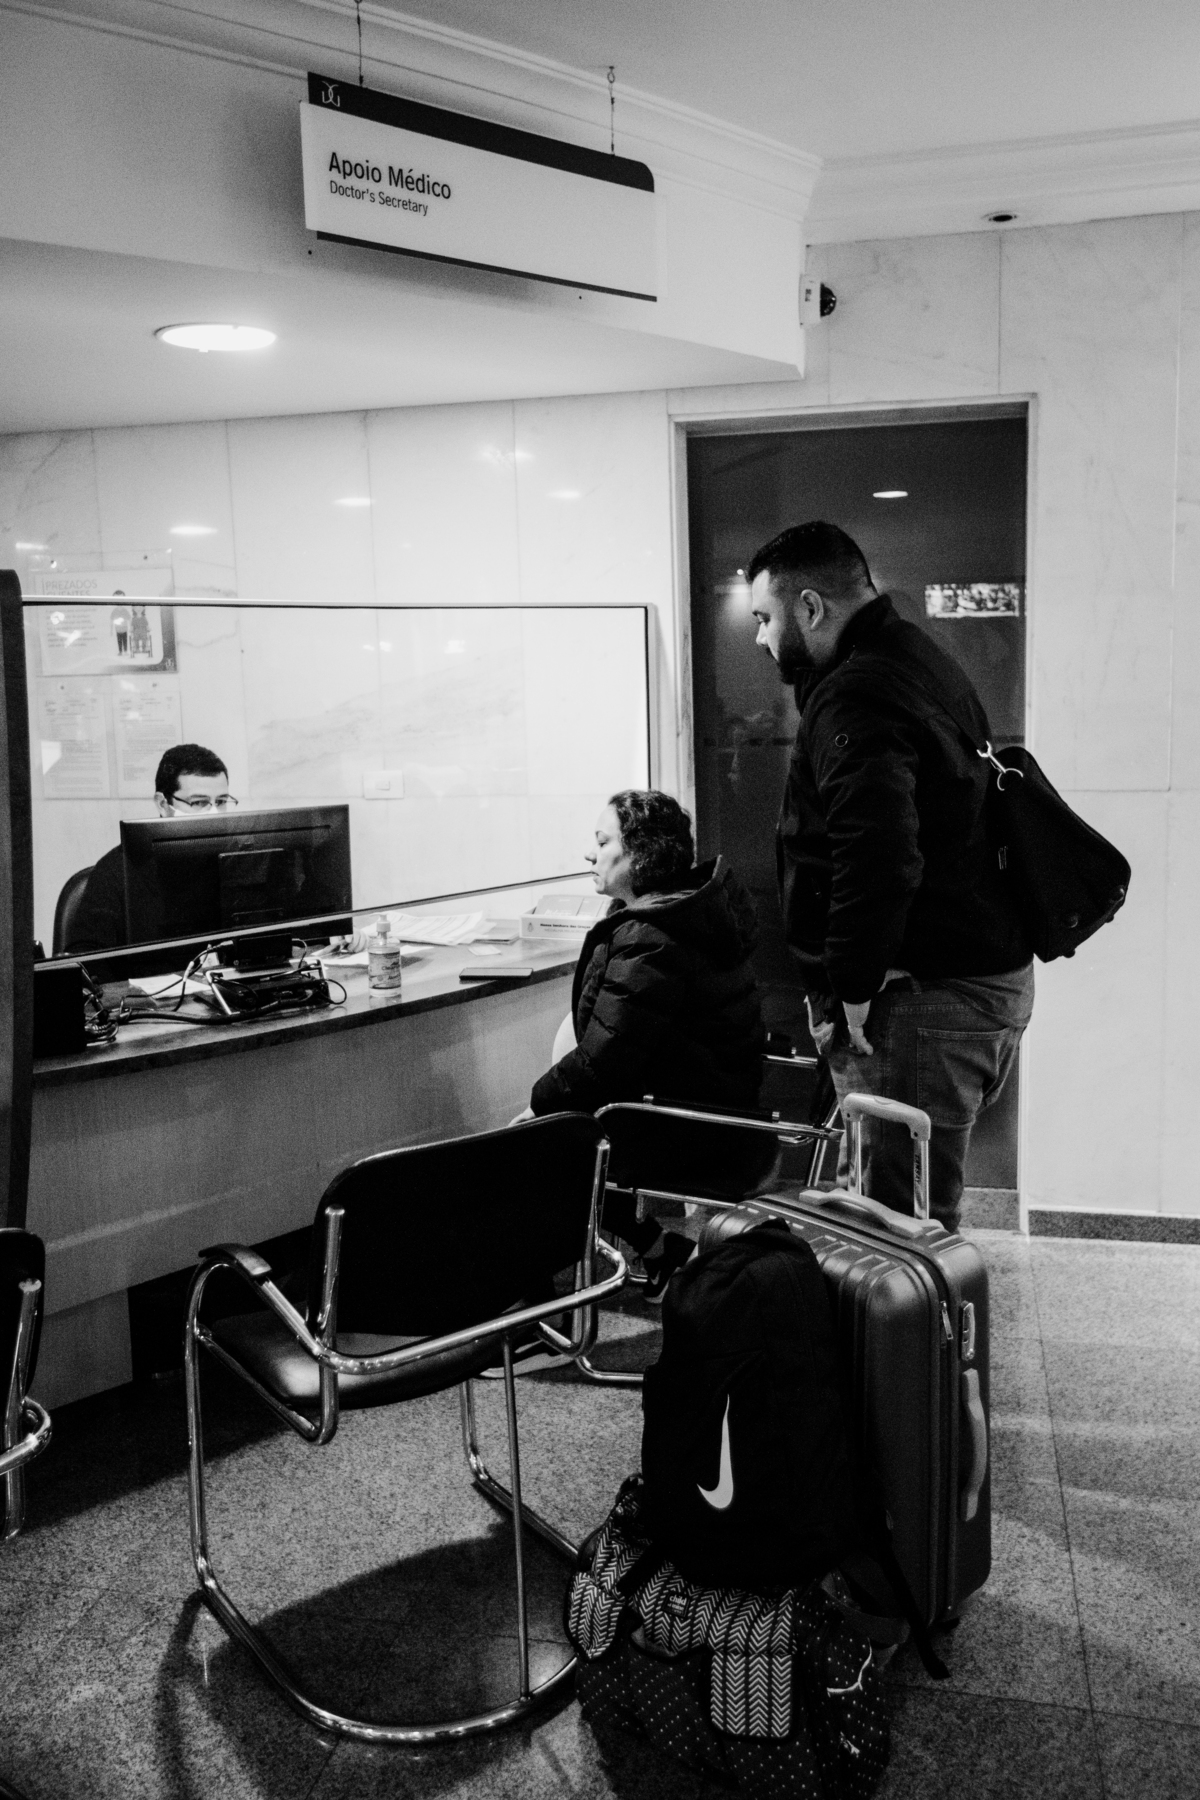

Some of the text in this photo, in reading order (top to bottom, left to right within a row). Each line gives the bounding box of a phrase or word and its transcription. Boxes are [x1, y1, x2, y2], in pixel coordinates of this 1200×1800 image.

[328, 152, 451, 199] Apoio Médico
[329, 180, 428, 216] Doctor's Secretary
[45, 579, 98, 591] PREZADOS
[669, 1595, 687, 1606] child
